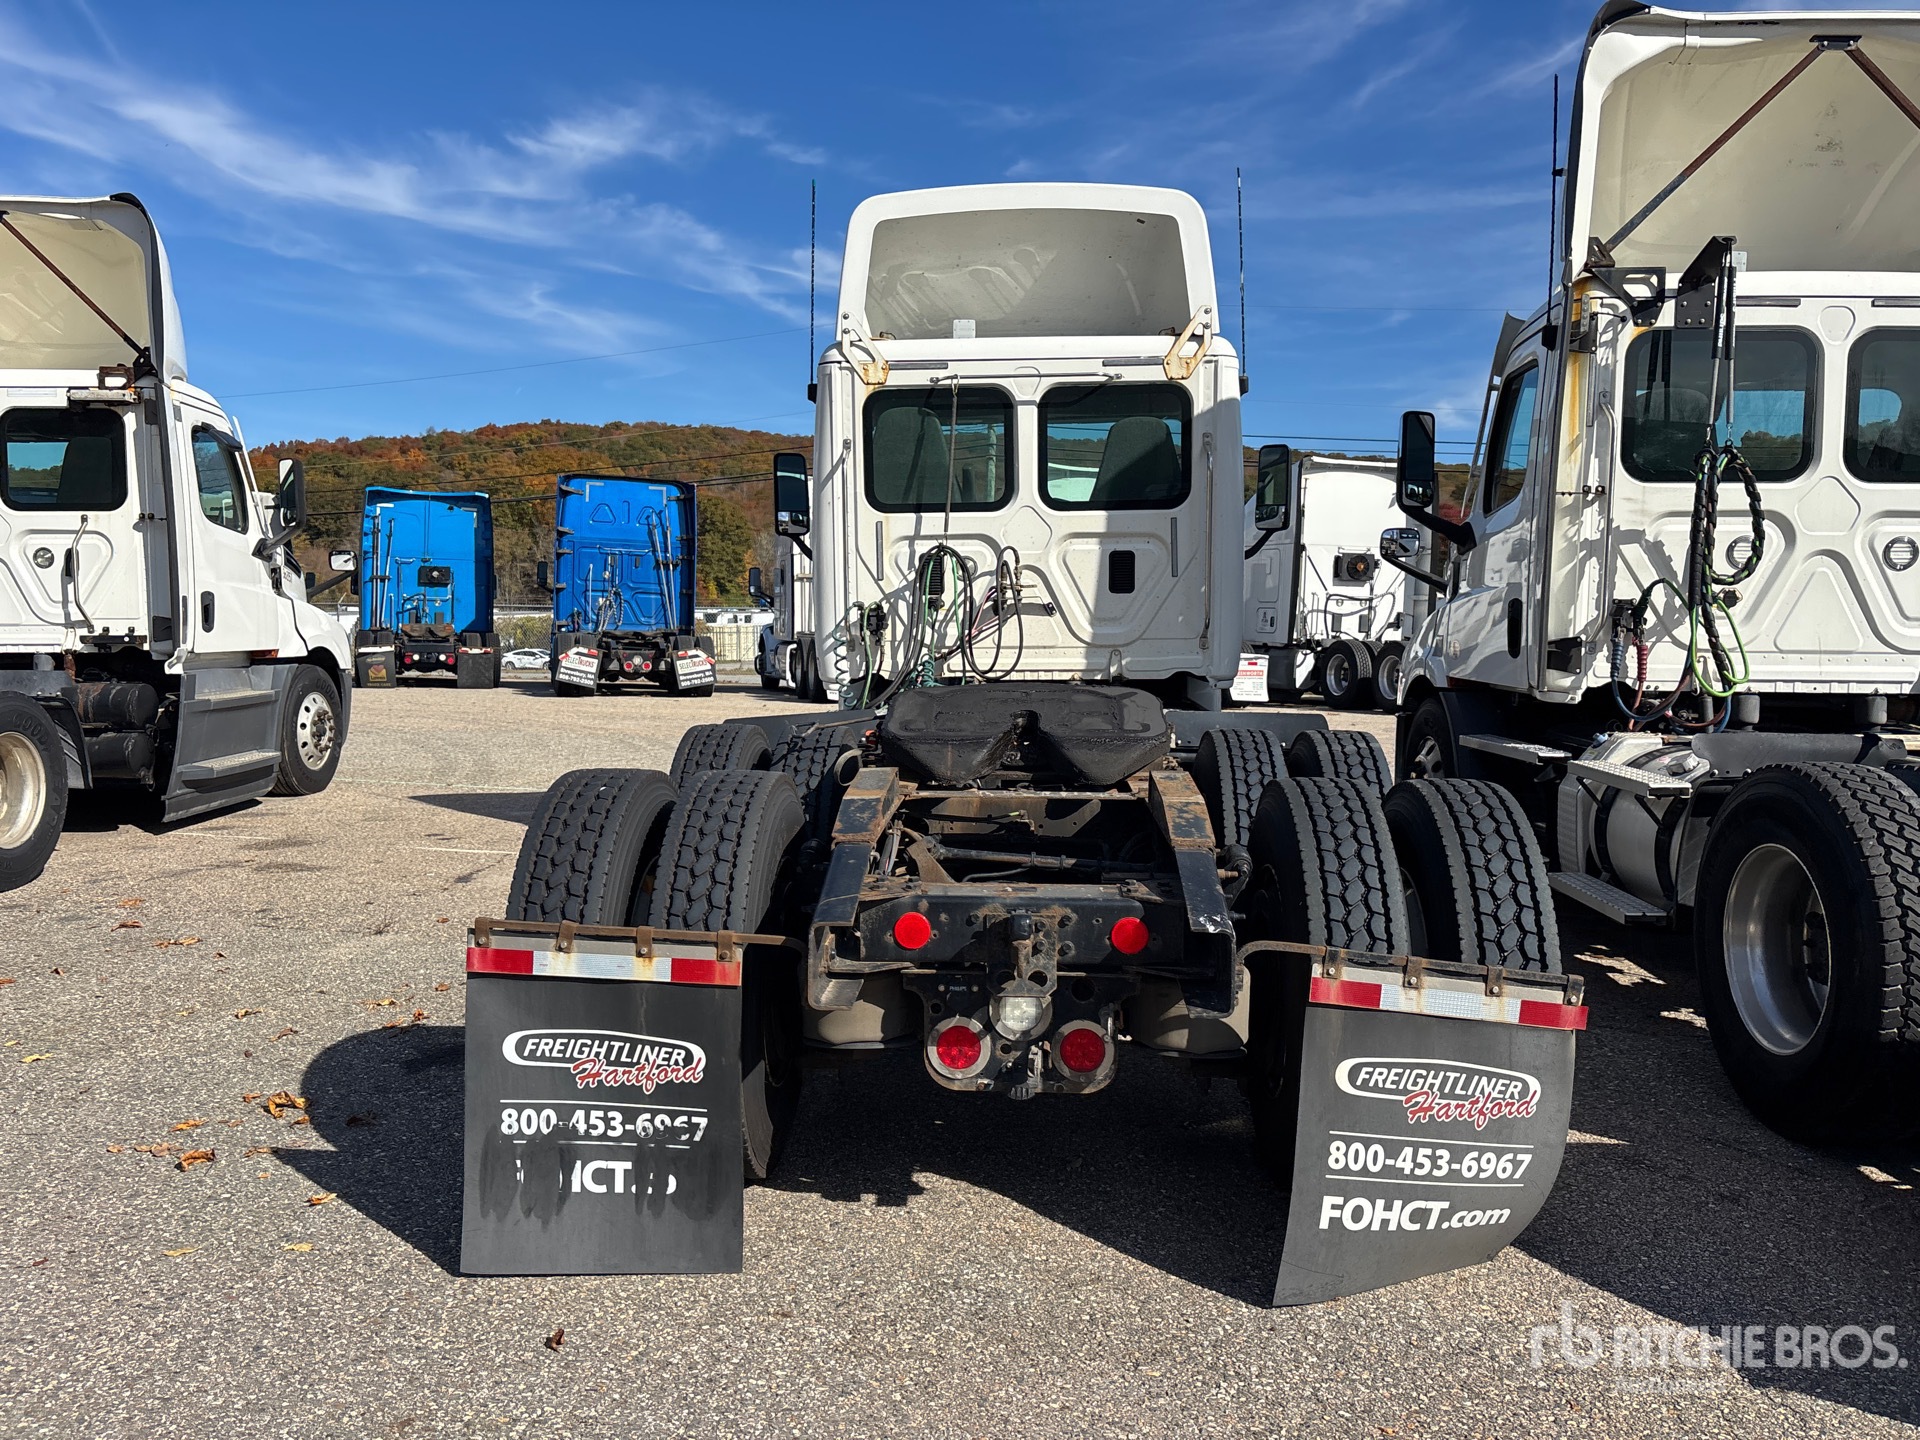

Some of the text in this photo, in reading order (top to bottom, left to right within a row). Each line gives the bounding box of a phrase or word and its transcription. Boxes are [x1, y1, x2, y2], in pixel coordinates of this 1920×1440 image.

[522, 1038, 686, 1066] FREIGHTLINER
[571, 1057, 704, 1094] Hartford
[1355, 1066, 1523, 1099] FREIGHTLINER
[1403, 1089, 1538, 1130] Hartford
[1327, 1140, 1533, 1179] 800-453-6967
[1318, 1195, 1511, 1231] FOHCT.com
